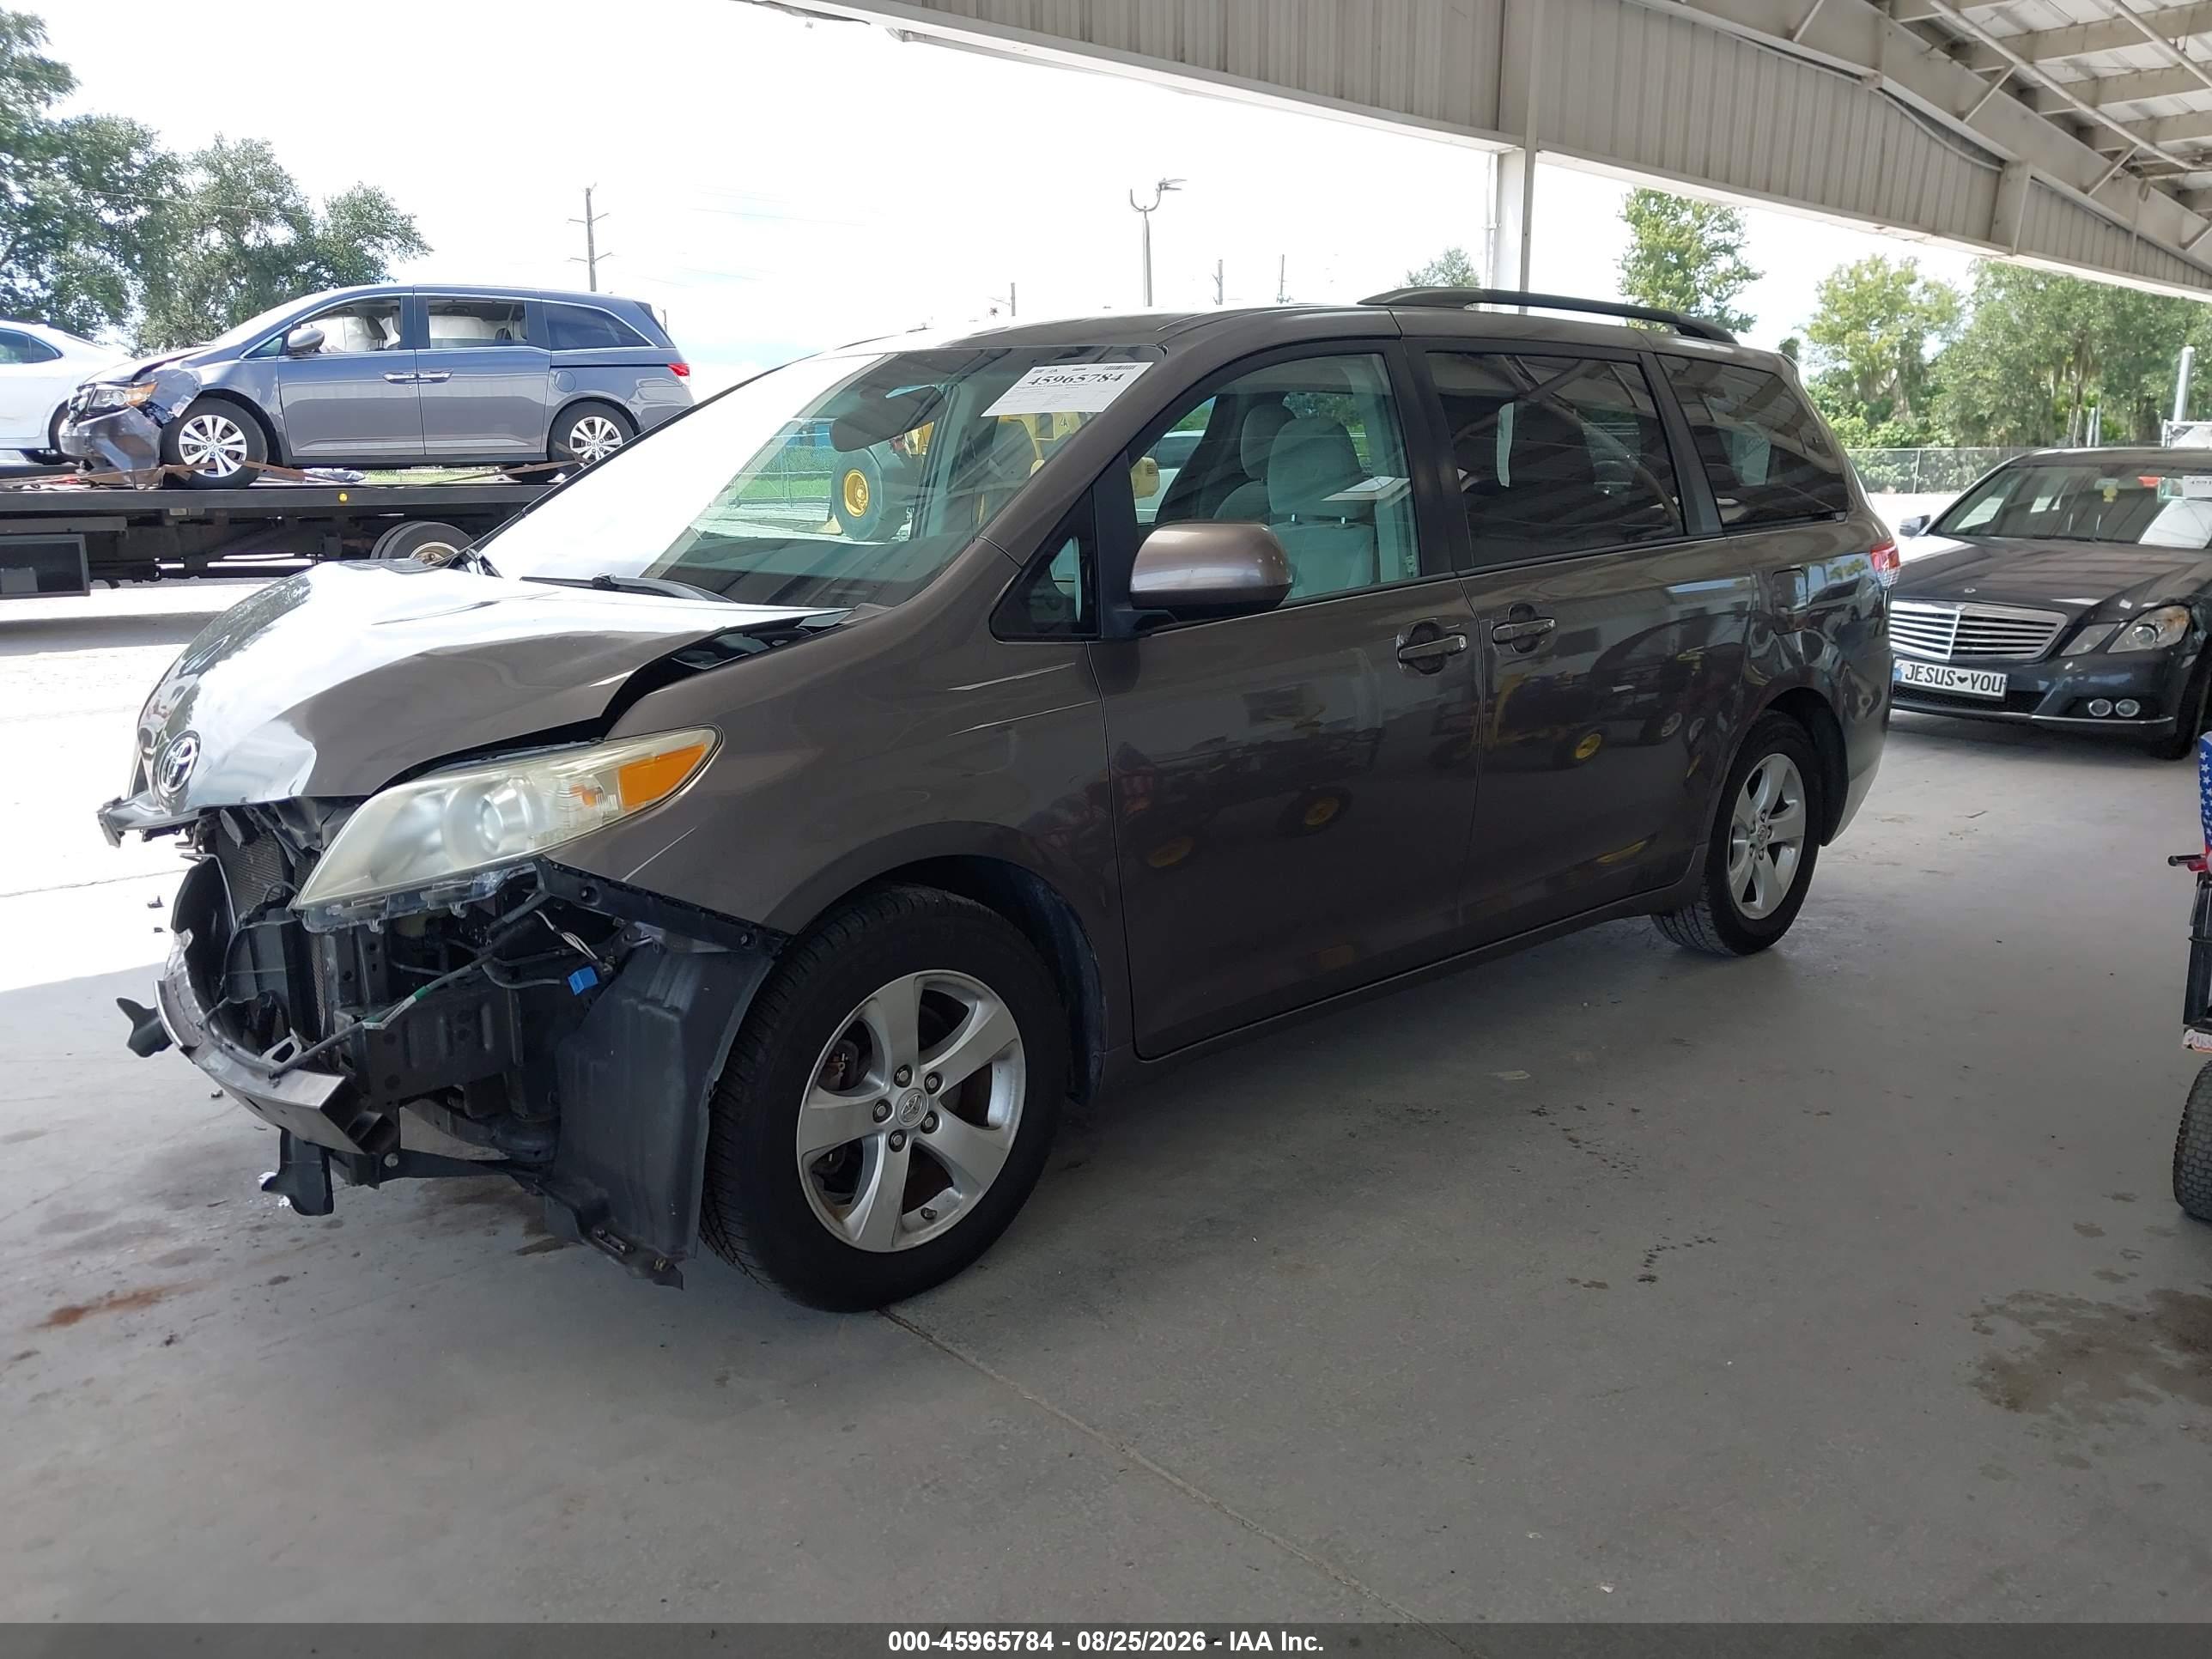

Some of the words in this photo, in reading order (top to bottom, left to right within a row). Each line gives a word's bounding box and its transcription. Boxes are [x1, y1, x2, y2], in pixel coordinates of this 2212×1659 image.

[1028, 373, 1125, 386] 45965784
[1905, 664, 1956, 687] JESUS
[1970, 672, 2004, 693] YOU
